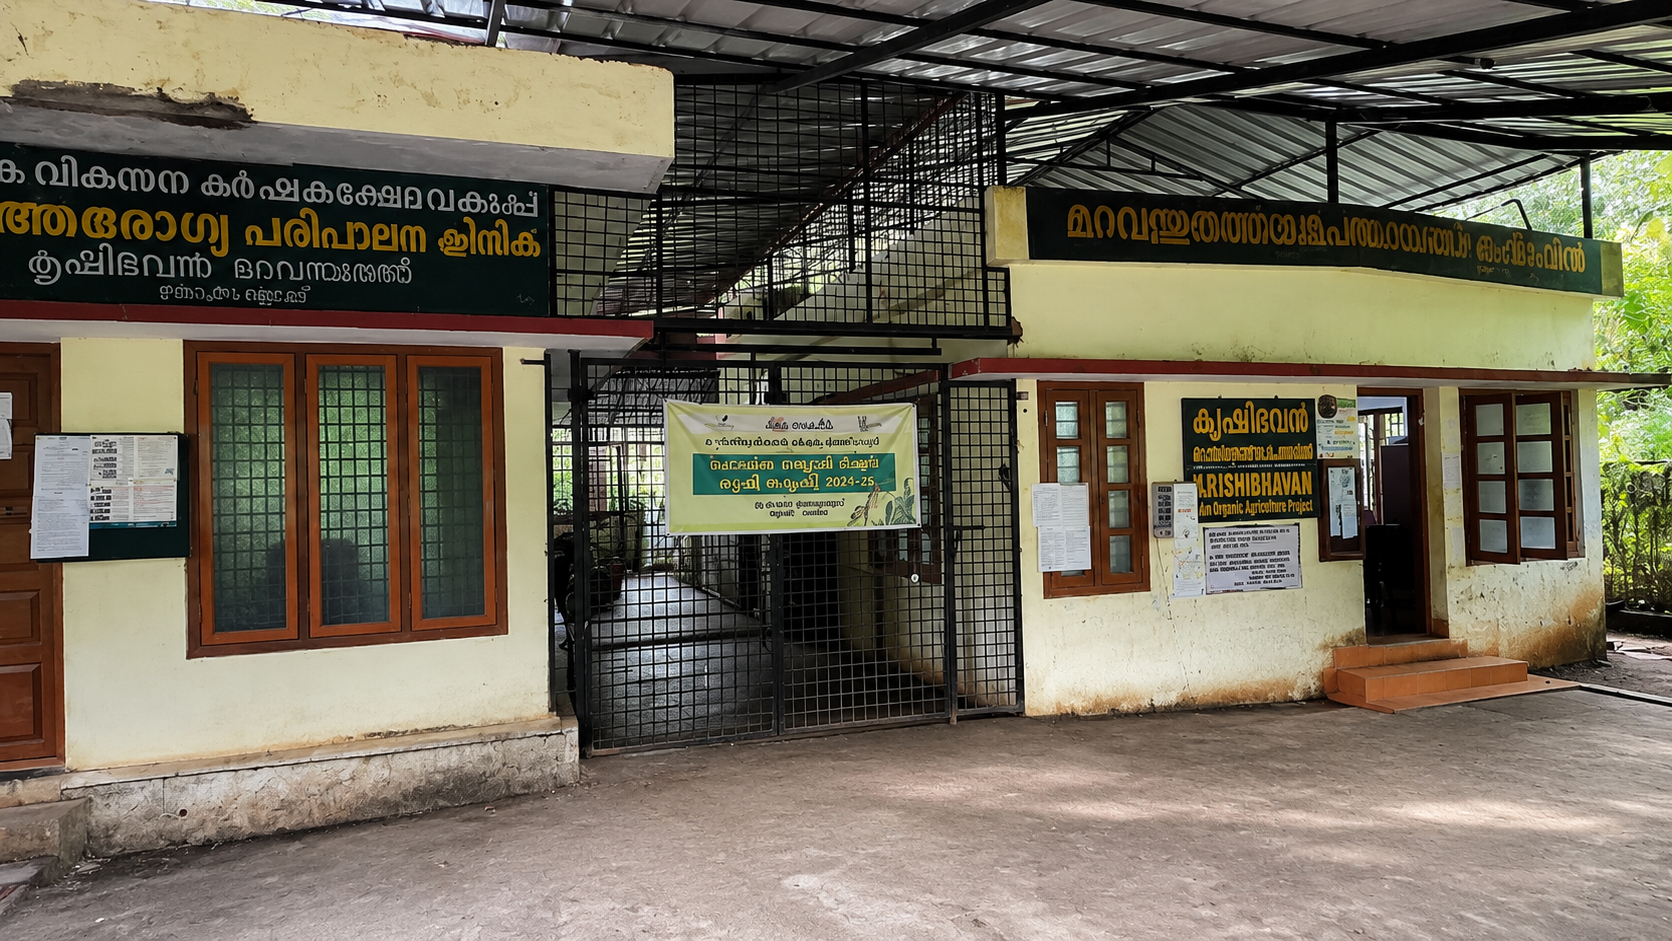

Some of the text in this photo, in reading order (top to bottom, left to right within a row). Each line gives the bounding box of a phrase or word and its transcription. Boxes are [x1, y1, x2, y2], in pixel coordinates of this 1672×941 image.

[35, 155, 189, 194] വികസന
[245, 207, 426, 252] പരിപാലന
[1193, 401, 1309, 441] കൃഷിഭവൻ
[1213, 500, 1243, 518] Organic
[1287, 498, 1313, 515] Project
